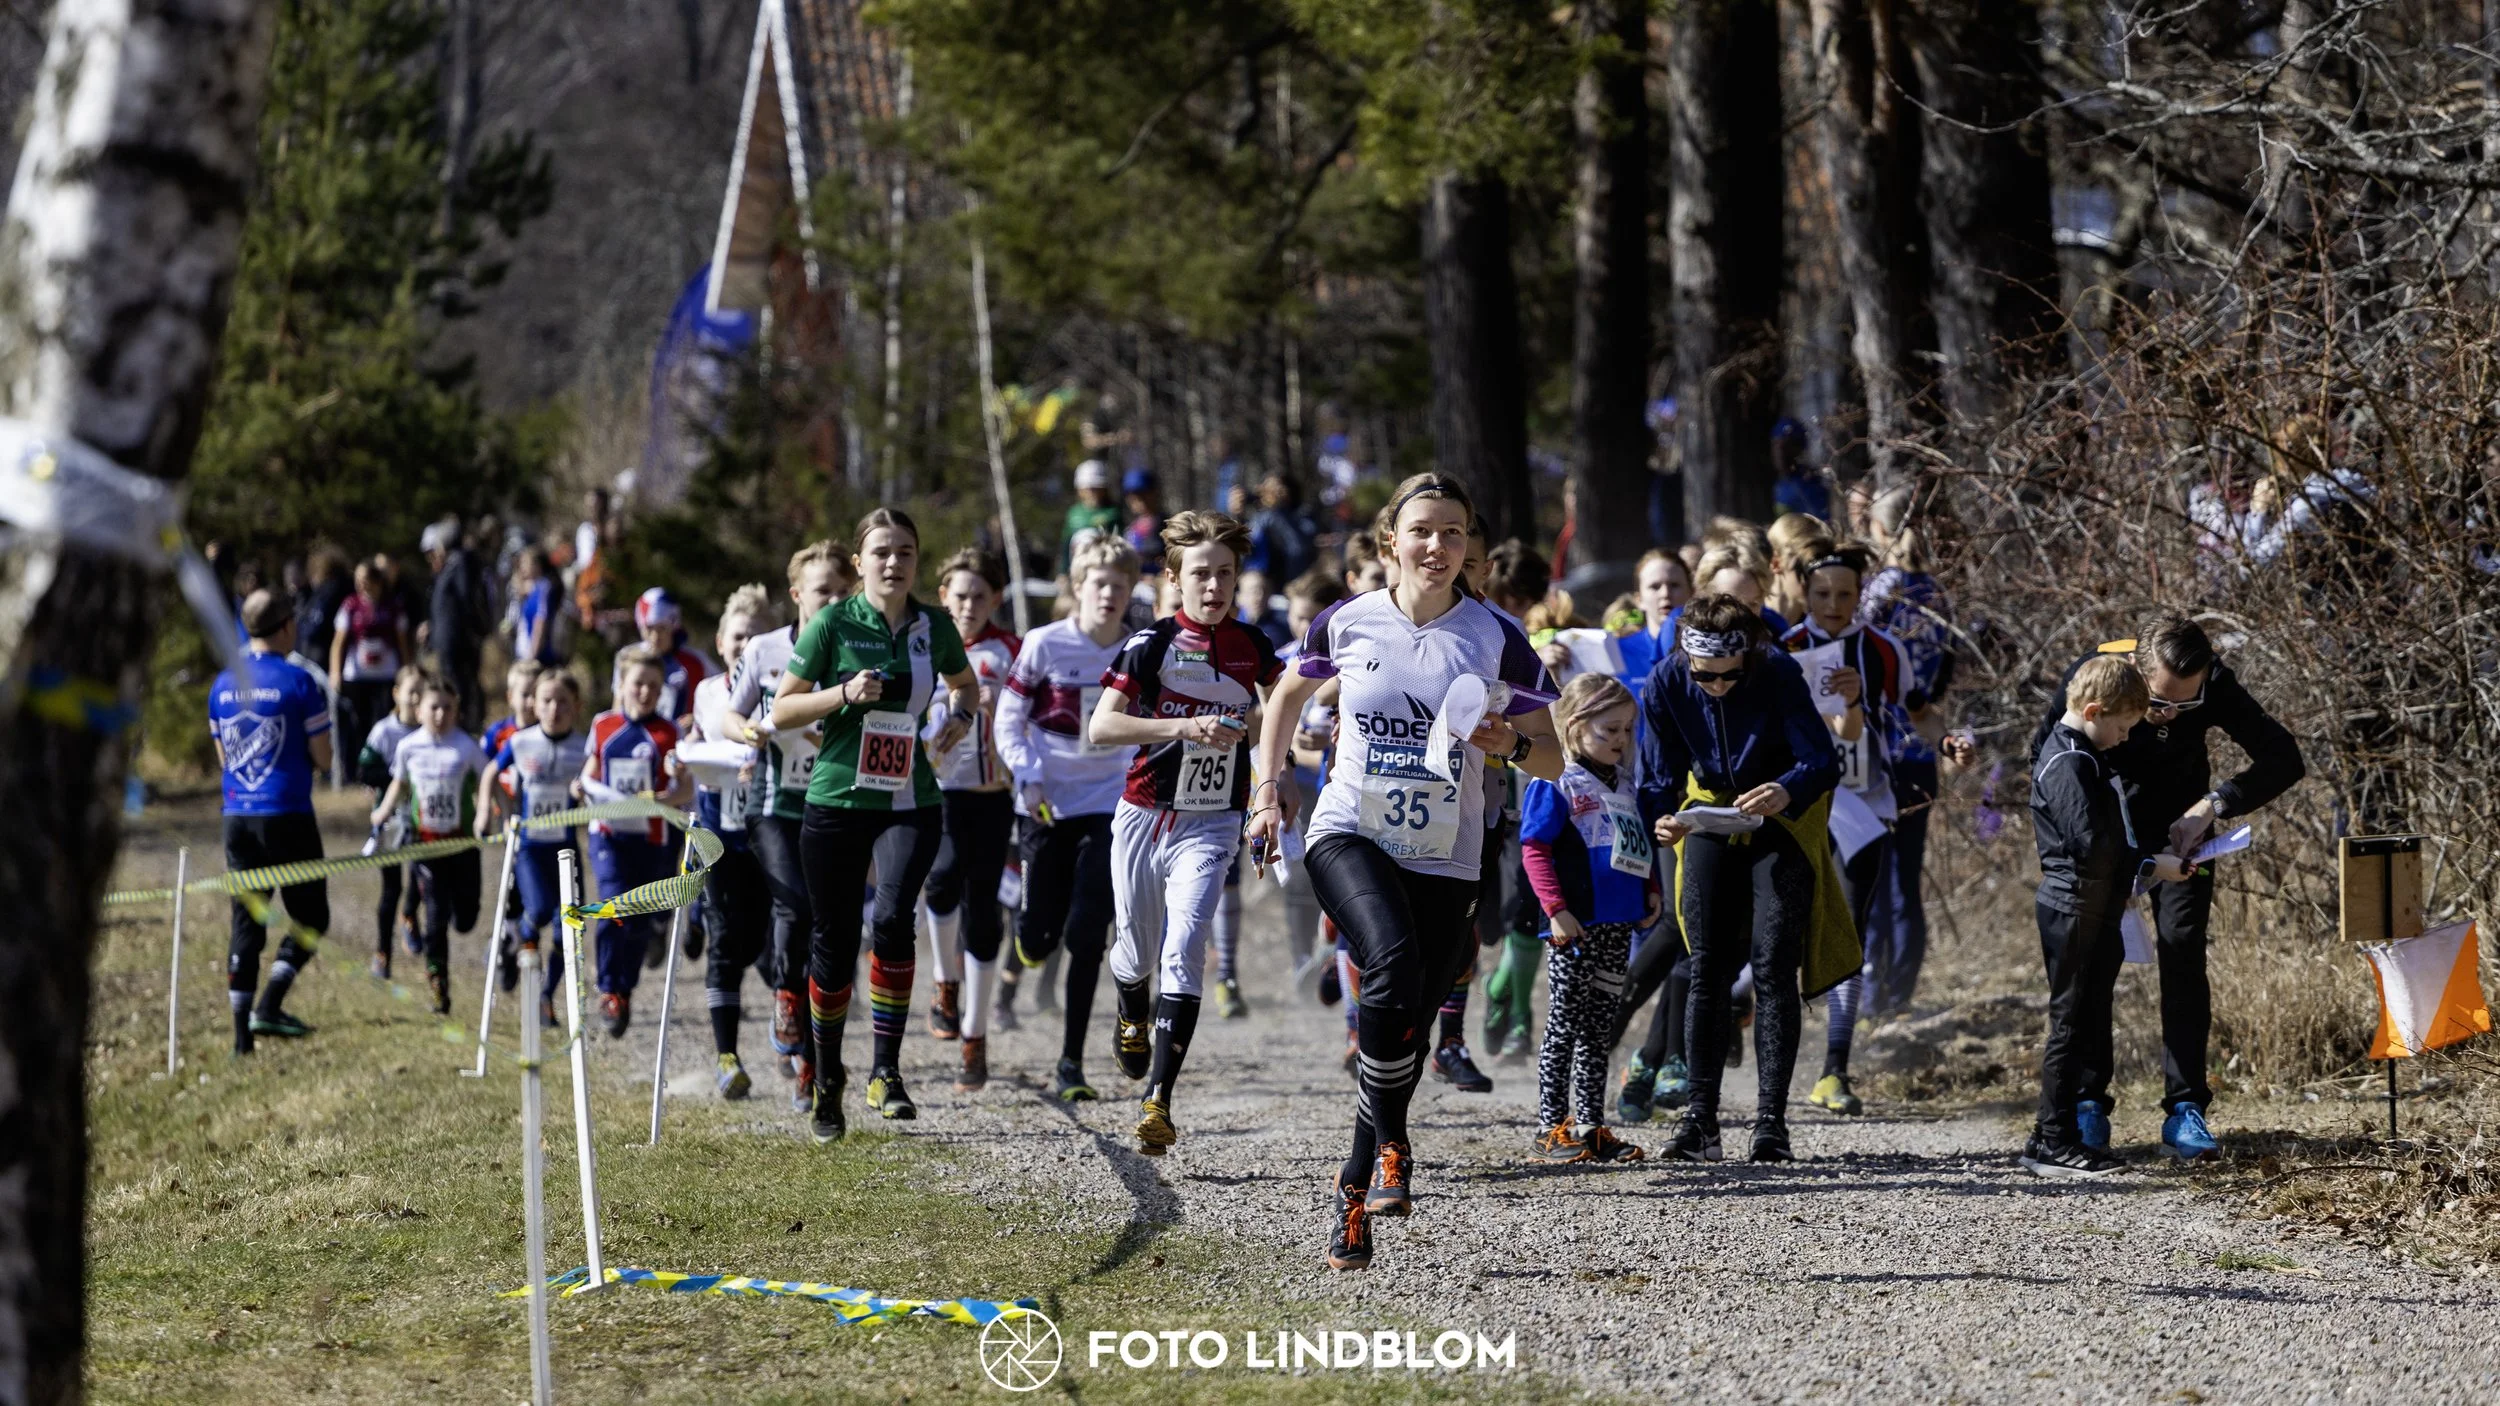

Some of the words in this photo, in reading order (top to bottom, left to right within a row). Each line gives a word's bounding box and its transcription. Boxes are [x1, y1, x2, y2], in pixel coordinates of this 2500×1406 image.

[844, 639, 886, 649] ALEWALDS
[1161, 701, 1190, 717] OK
[1355, 711, 1433, 740] SÖDE
[867, 735, 907, 774] 839
[1836, 742, 1858, 777] 81
[865, 776, 876, 785] OK
[1187, 754, 1228, 792] 795
[1380, 767, 1427, 779] STAFETTLIGAN
[1198, 797, 1223, 806] Måsen
[1443, 785, 1457, 803] 2
[1384, 788, 1430, 831] 35
